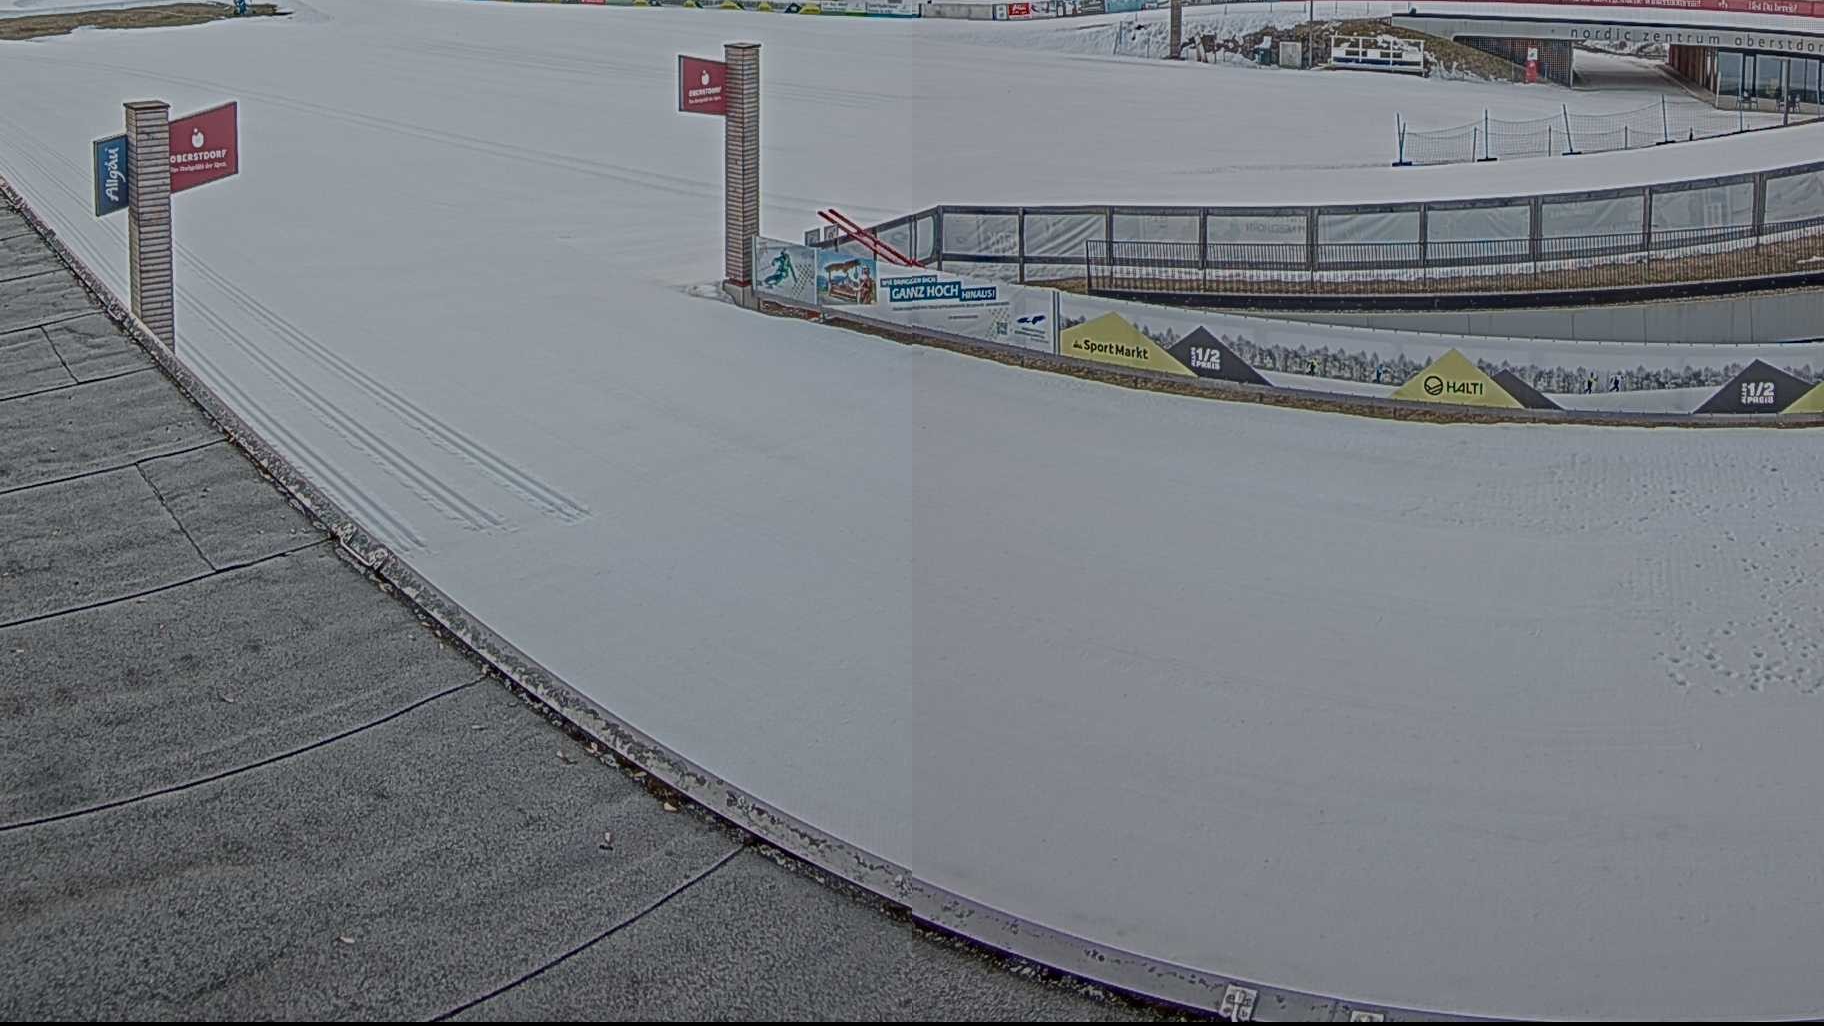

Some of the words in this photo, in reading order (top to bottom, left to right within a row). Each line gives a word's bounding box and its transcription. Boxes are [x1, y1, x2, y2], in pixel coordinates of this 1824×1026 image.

[1570, 27, 1632, 41] nordic
[1643, 30, 1720, 45] zentrum
[169, 149, 227, 164] OBERSTDORF
[105, 146, 127, 203] Allgäu
[927, 284, 960, 297] HOCH
[1196, 347, 1220, 362] 1/2
[1446, 380, 1484, 395] HALTI
[1747, 382, 1775, 396] 1/2
